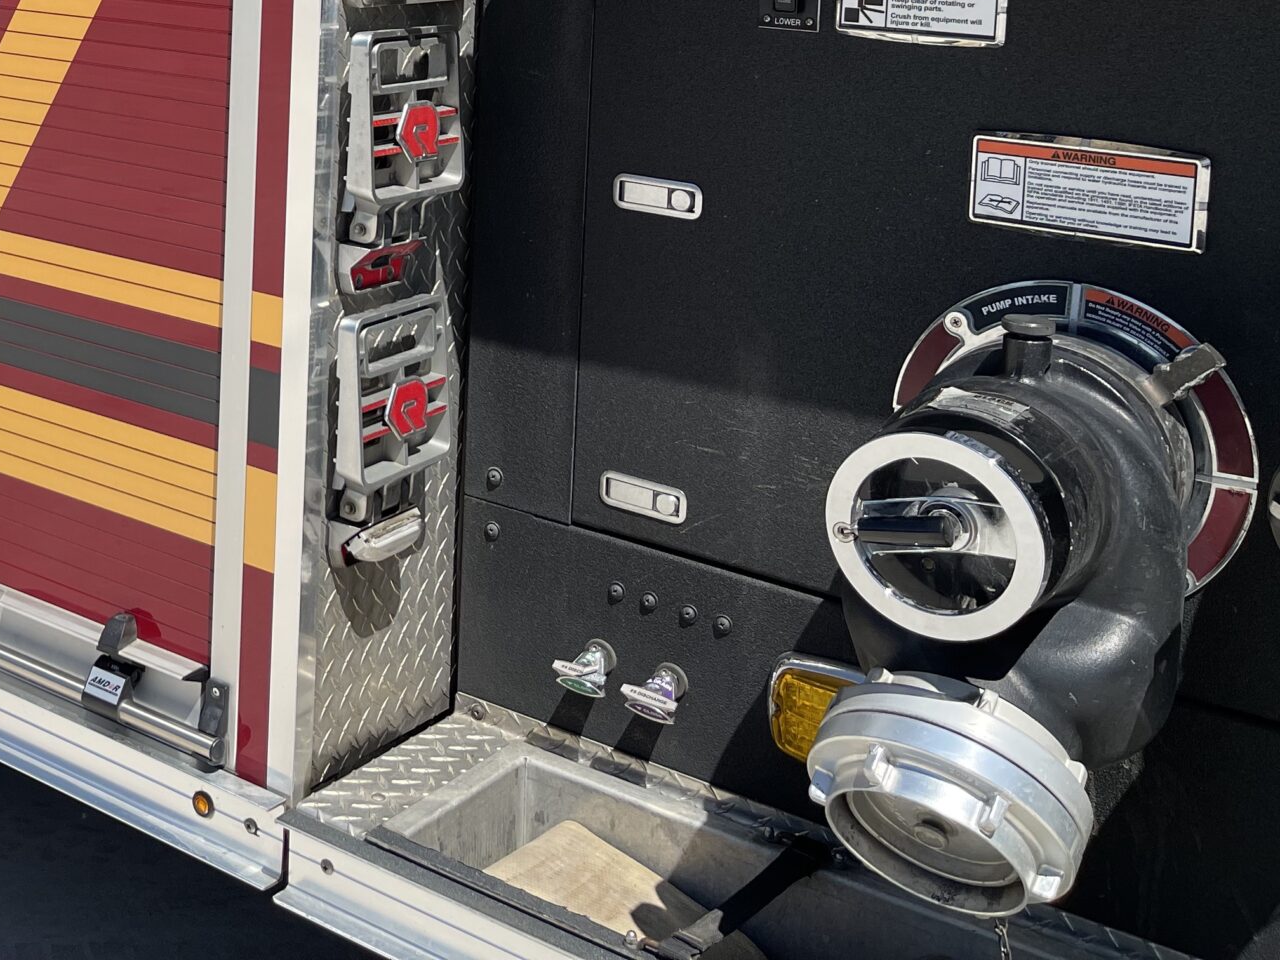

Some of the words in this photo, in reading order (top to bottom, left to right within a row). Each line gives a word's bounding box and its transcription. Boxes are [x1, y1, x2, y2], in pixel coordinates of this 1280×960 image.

[891, 3, 923, 12] swinging
[937, 0, 966, 9] rotating
[774, 17, 801, 26] LOWER
[890, 12, 912, 20] Crush
[913, 14, 930, 22] from
[930, 15, 969, 25] equipment
[890, 19, 910, 27] injure
[1062, 151, 1116, 166] WARNING
[981, 298, 1012, 316] PUMP
[1014, 294, 1058, 306] INTAKE
[1117, 299, 1171, 333] WARNING
[637, 691, 667, 705] DISCHARGE
